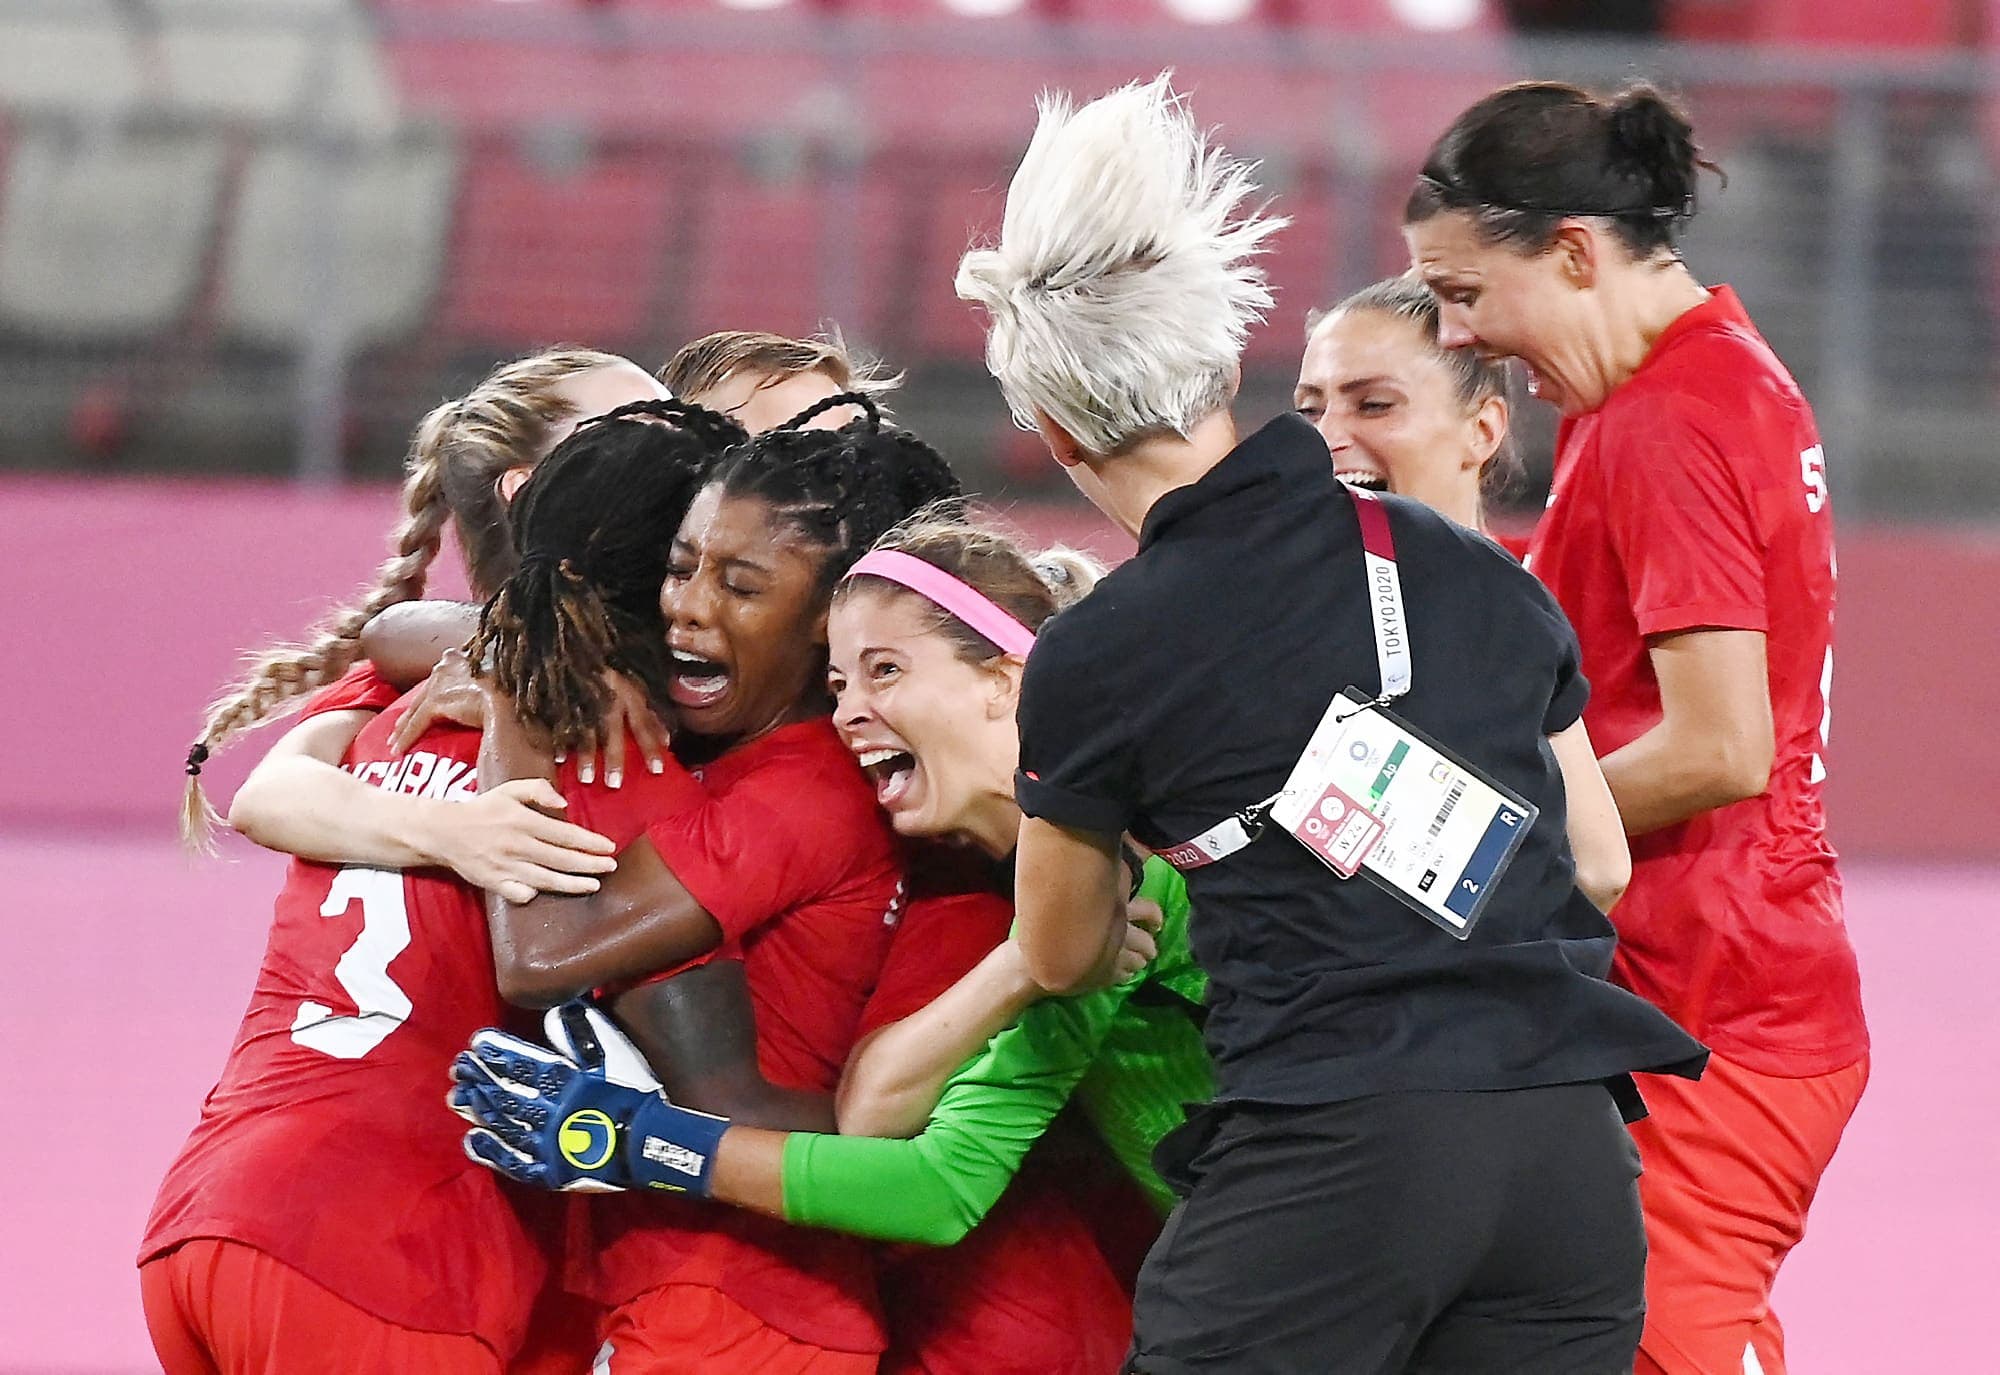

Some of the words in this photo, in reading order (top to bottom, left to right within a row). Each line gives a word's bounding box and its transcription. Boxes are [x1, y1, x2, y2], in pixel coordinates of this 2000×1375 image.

[1376, 566, 1394, 603] 2020
[1381, 606, 1401, 657] TOKYO
[1383, 763, 1399, 779] Ap
[1462, 878, 1479, 895] 2
[1499, 810, 1520, 827] R
[290, 868, 413, 1059] 3
